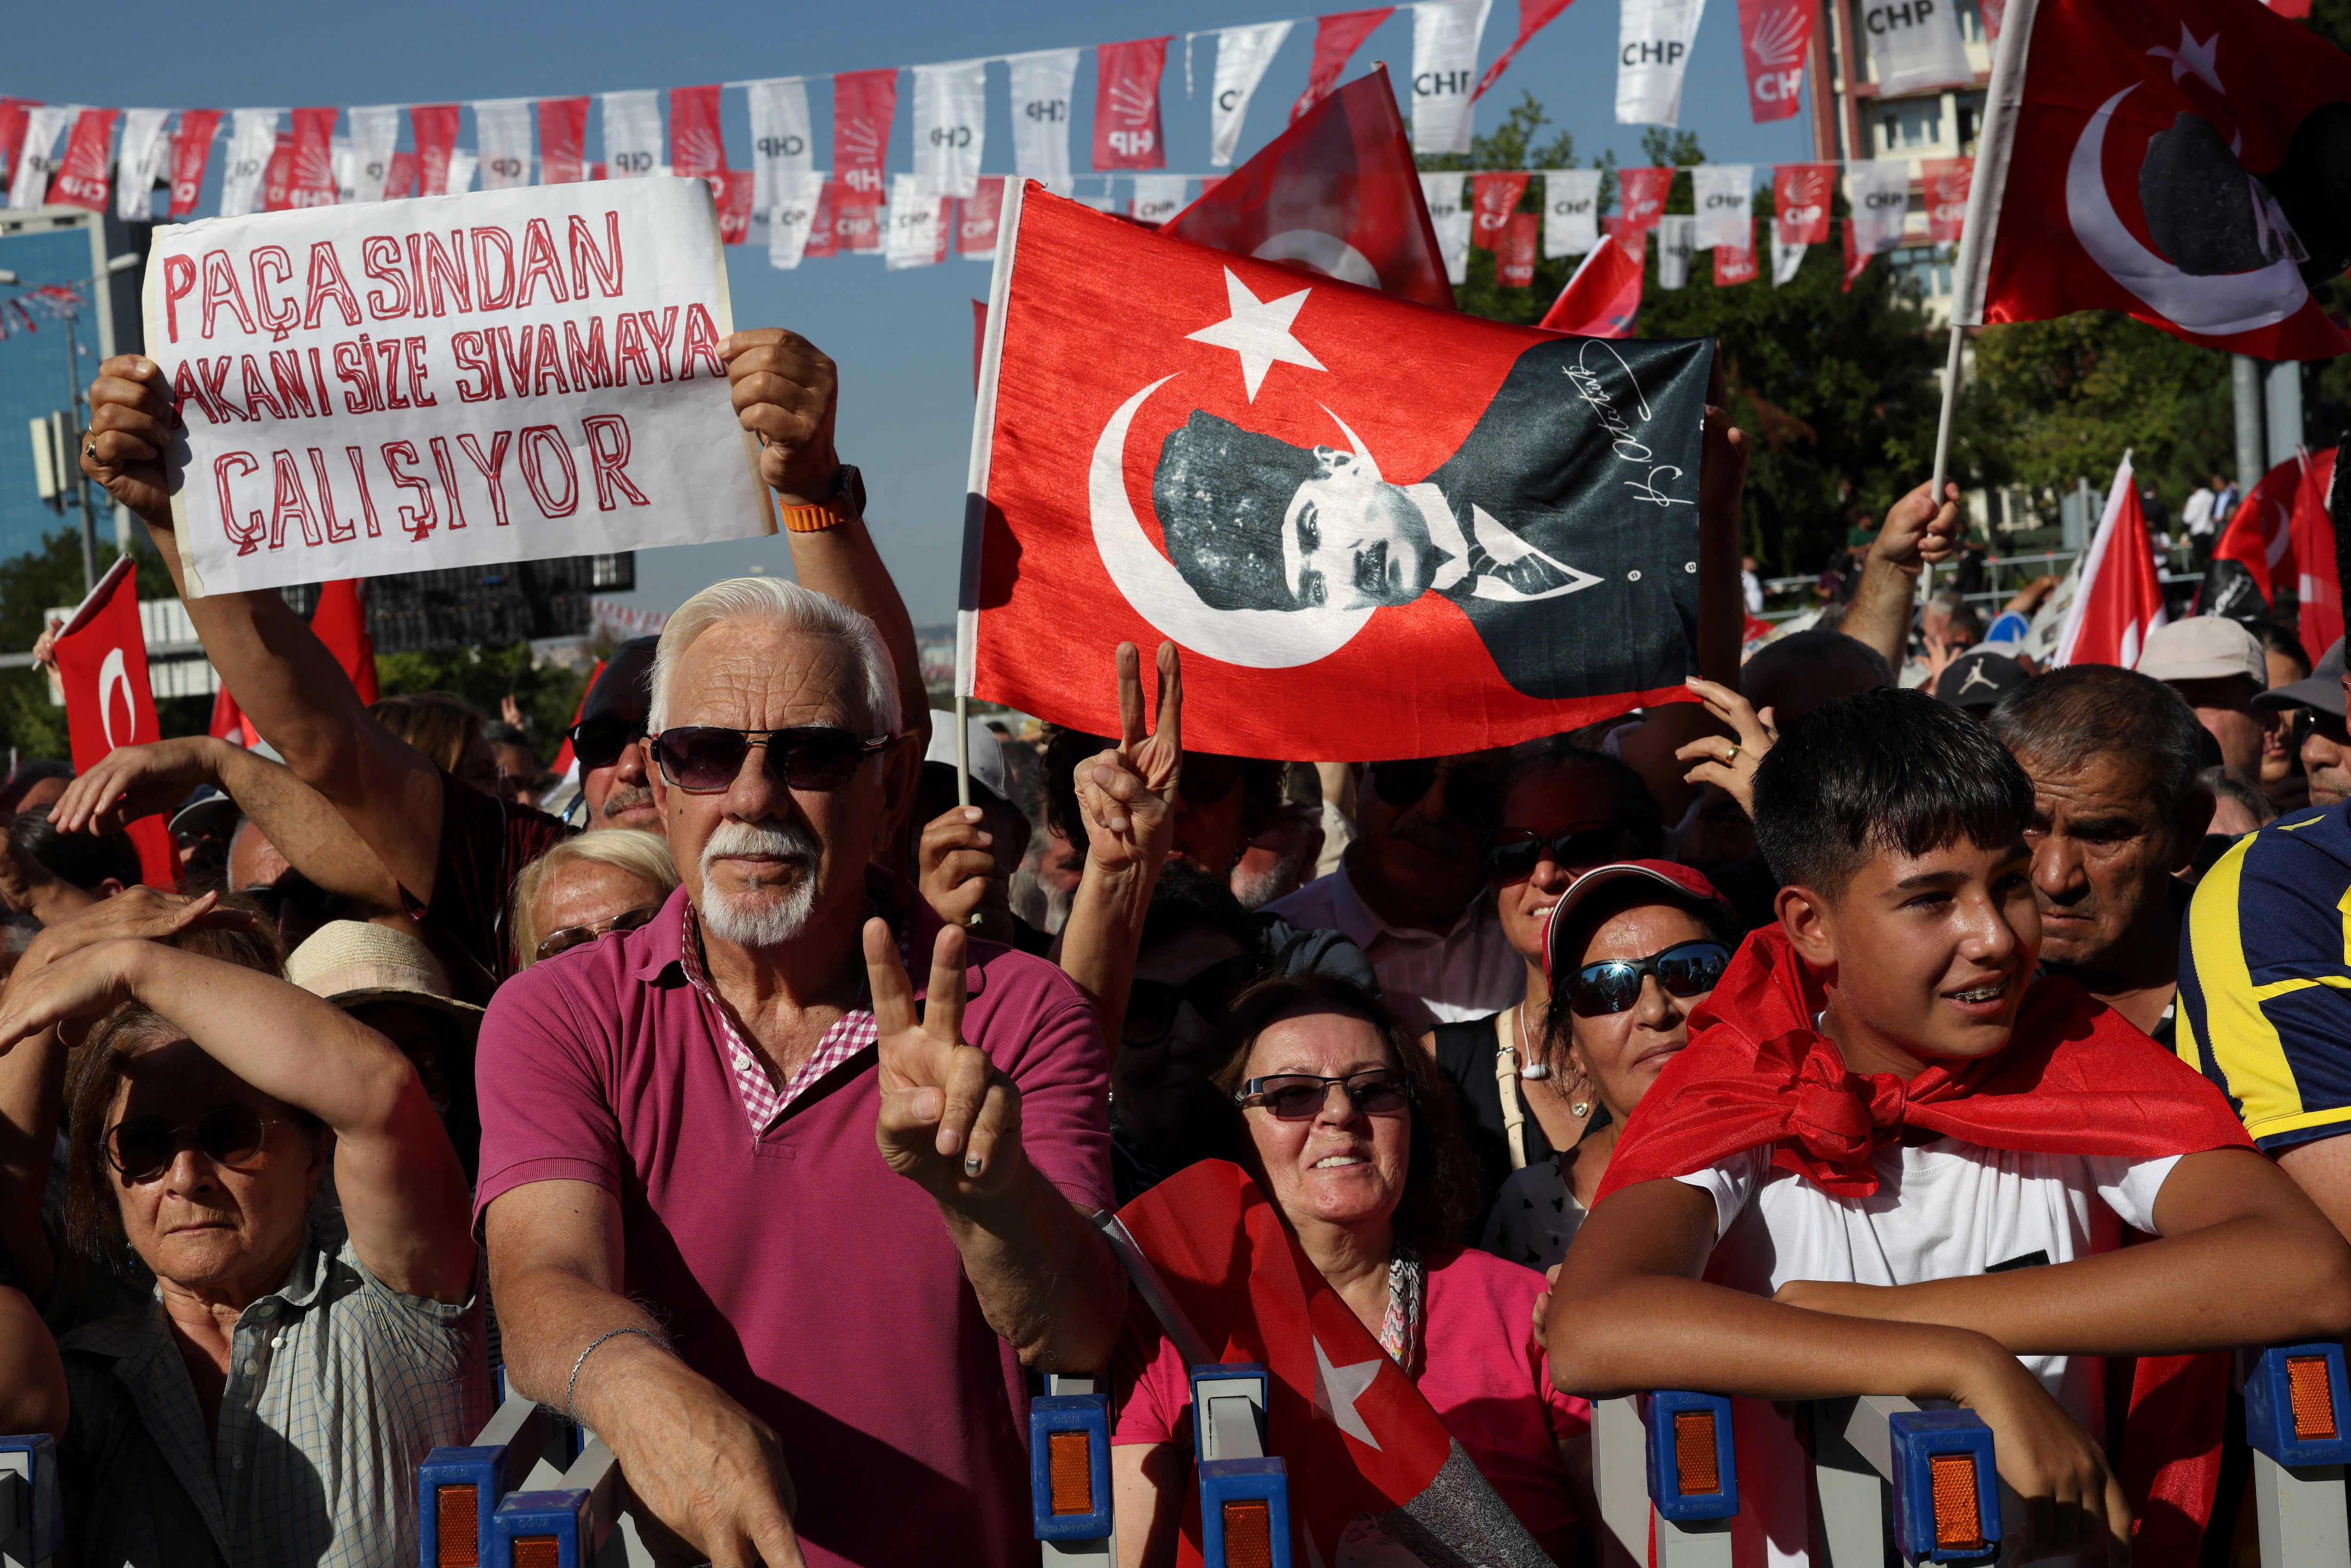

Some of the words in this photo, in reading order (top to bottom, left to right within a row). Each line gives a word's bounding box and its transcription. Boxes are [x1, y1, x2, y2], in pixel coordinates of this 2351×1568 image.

[1866, 0, 1936, 37] CHP
[1622, 40, 1686, 66] CHP
[1554, 198, 1593, 216] CHP
[1705, 193, 1744, 210] CHP
[1784, 204, 1822, 226] CHP
[164, 211, 623, 343] PAÇASINDAN
[450, 303, 728, 403] SIVAMAYA
[214, 414, 651, 556] ÇALIŞIYOR
